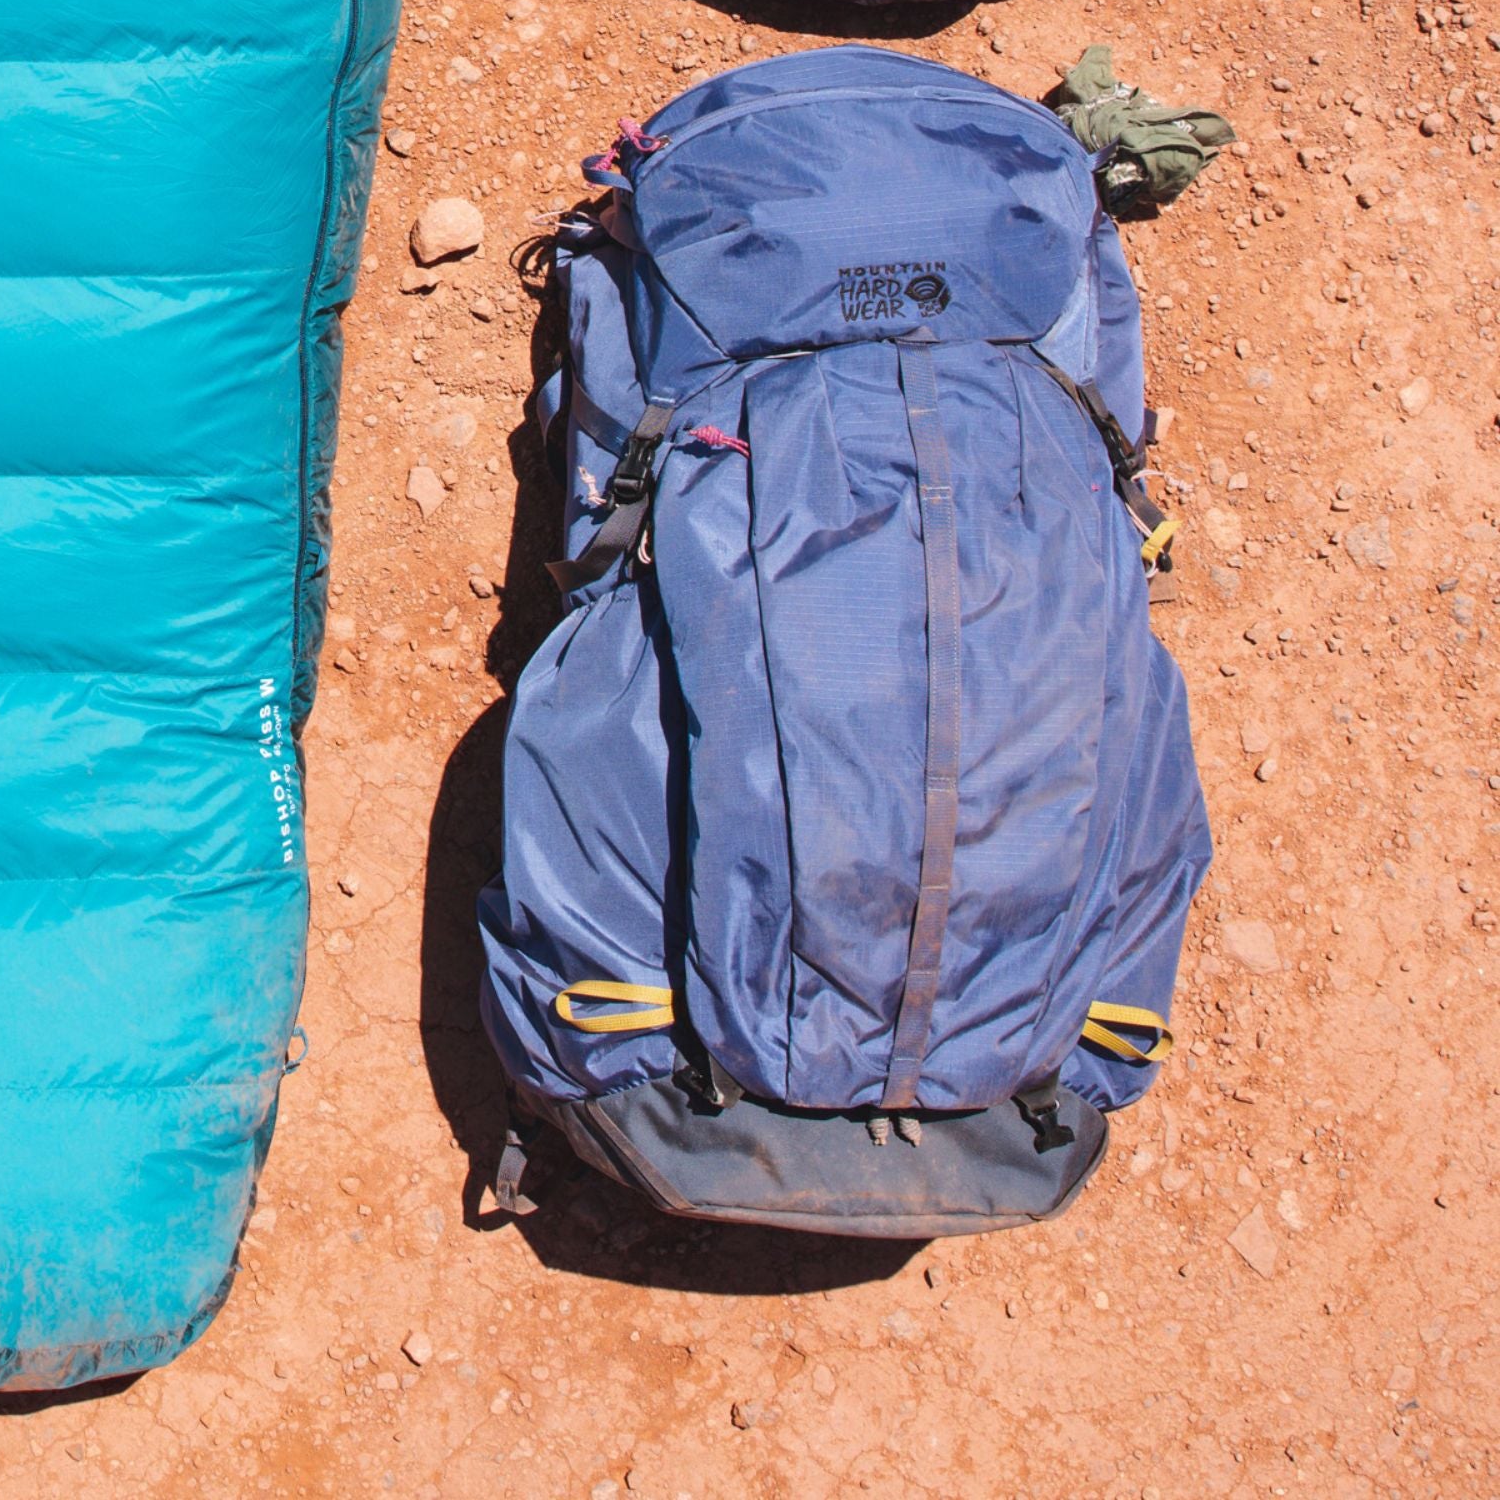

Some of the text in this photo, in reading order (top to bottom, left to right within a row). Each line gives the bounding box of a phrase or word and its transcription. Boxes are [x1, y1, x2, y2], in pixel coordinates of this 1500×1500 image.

[838, 261, 946, 278] MOUNTAIN
[839, 278, 902, 301] HARD
[840, 299, 906, 323] WEAR
[259, 677, 294, 864] BISHOP PASS W
